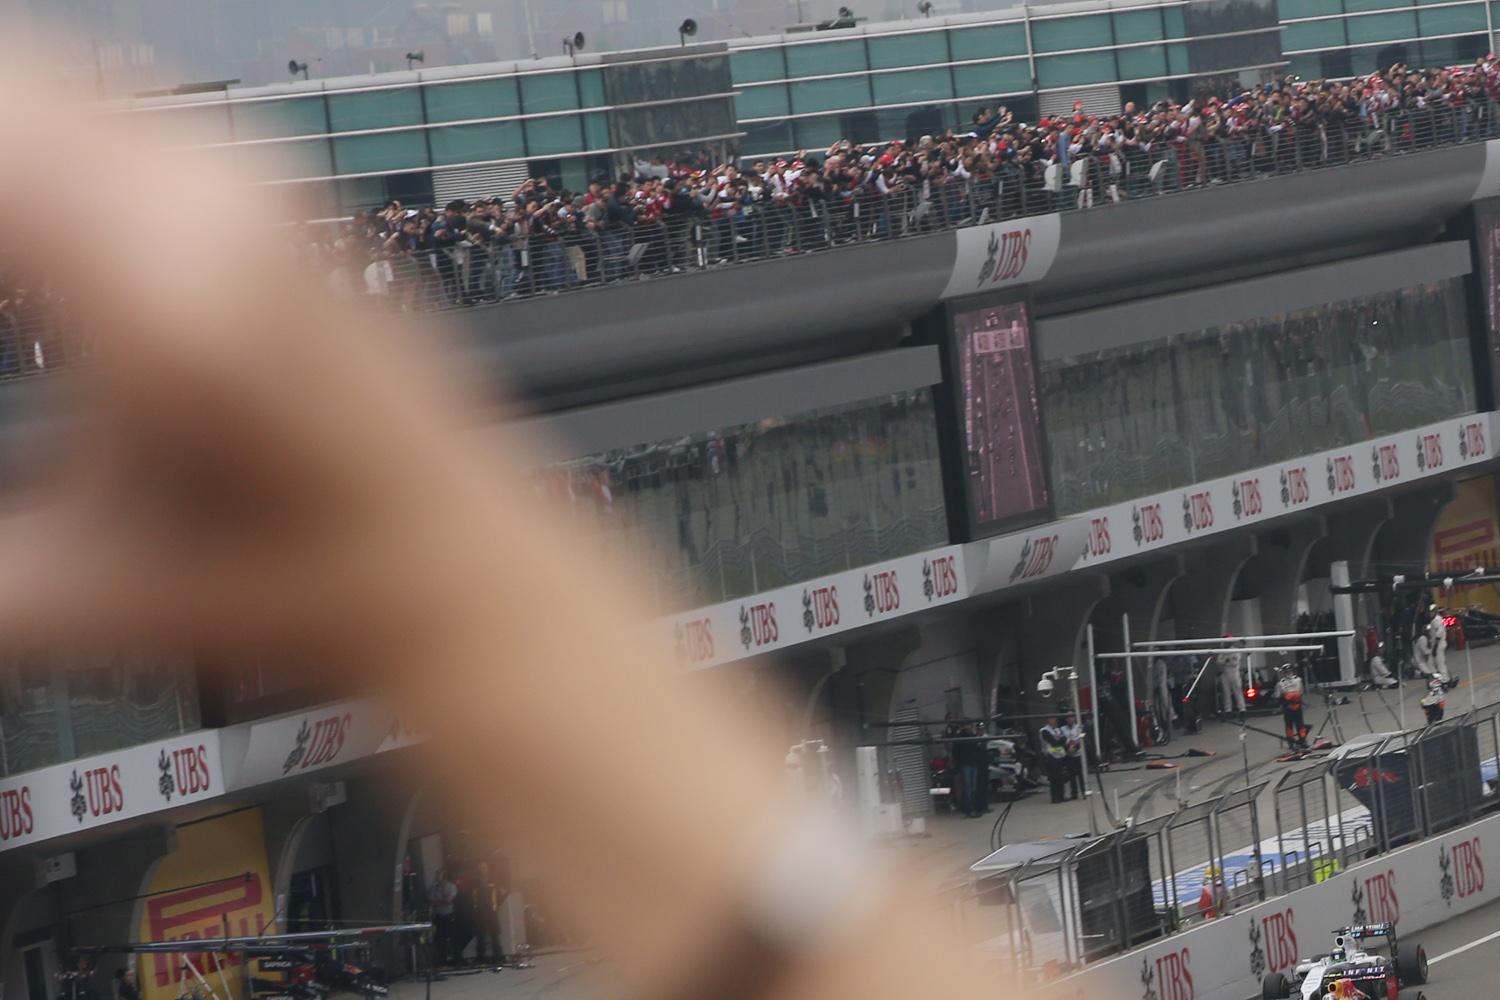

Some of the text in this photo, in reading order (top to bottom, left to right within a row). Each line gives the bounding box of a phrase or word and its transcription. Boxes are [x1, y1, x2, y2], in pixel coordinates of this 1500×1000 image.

[994, 228, 1033, 281] UBS
[1190, 491, 1214, 530] UBS
[1239, 478, 1262, 516] UBS
[1140, 503, 1164, 542] UBS
[932, 555, 958, 598] UBS
[1021, 534, 1059, 579] UBS
[812, 585, 840, 629] UBS
[873, 570, 900, 612] UBS
[685, 618, 714, 662] UBS
[750, 602, 779, 646] UBS
[301, 713, 352, 768] UBS
[85, 764, 123, 817] UBS
[173, 744, 209, 796] UBS
[0, 786, 33, 840] UBS
[1451, 836, 1485, 899] UBS
[1364, 868, 1400, 925] UBS
[1262, 907, 1299, 974] UBS
[1343, 965, 1386, 976] INFNIT
